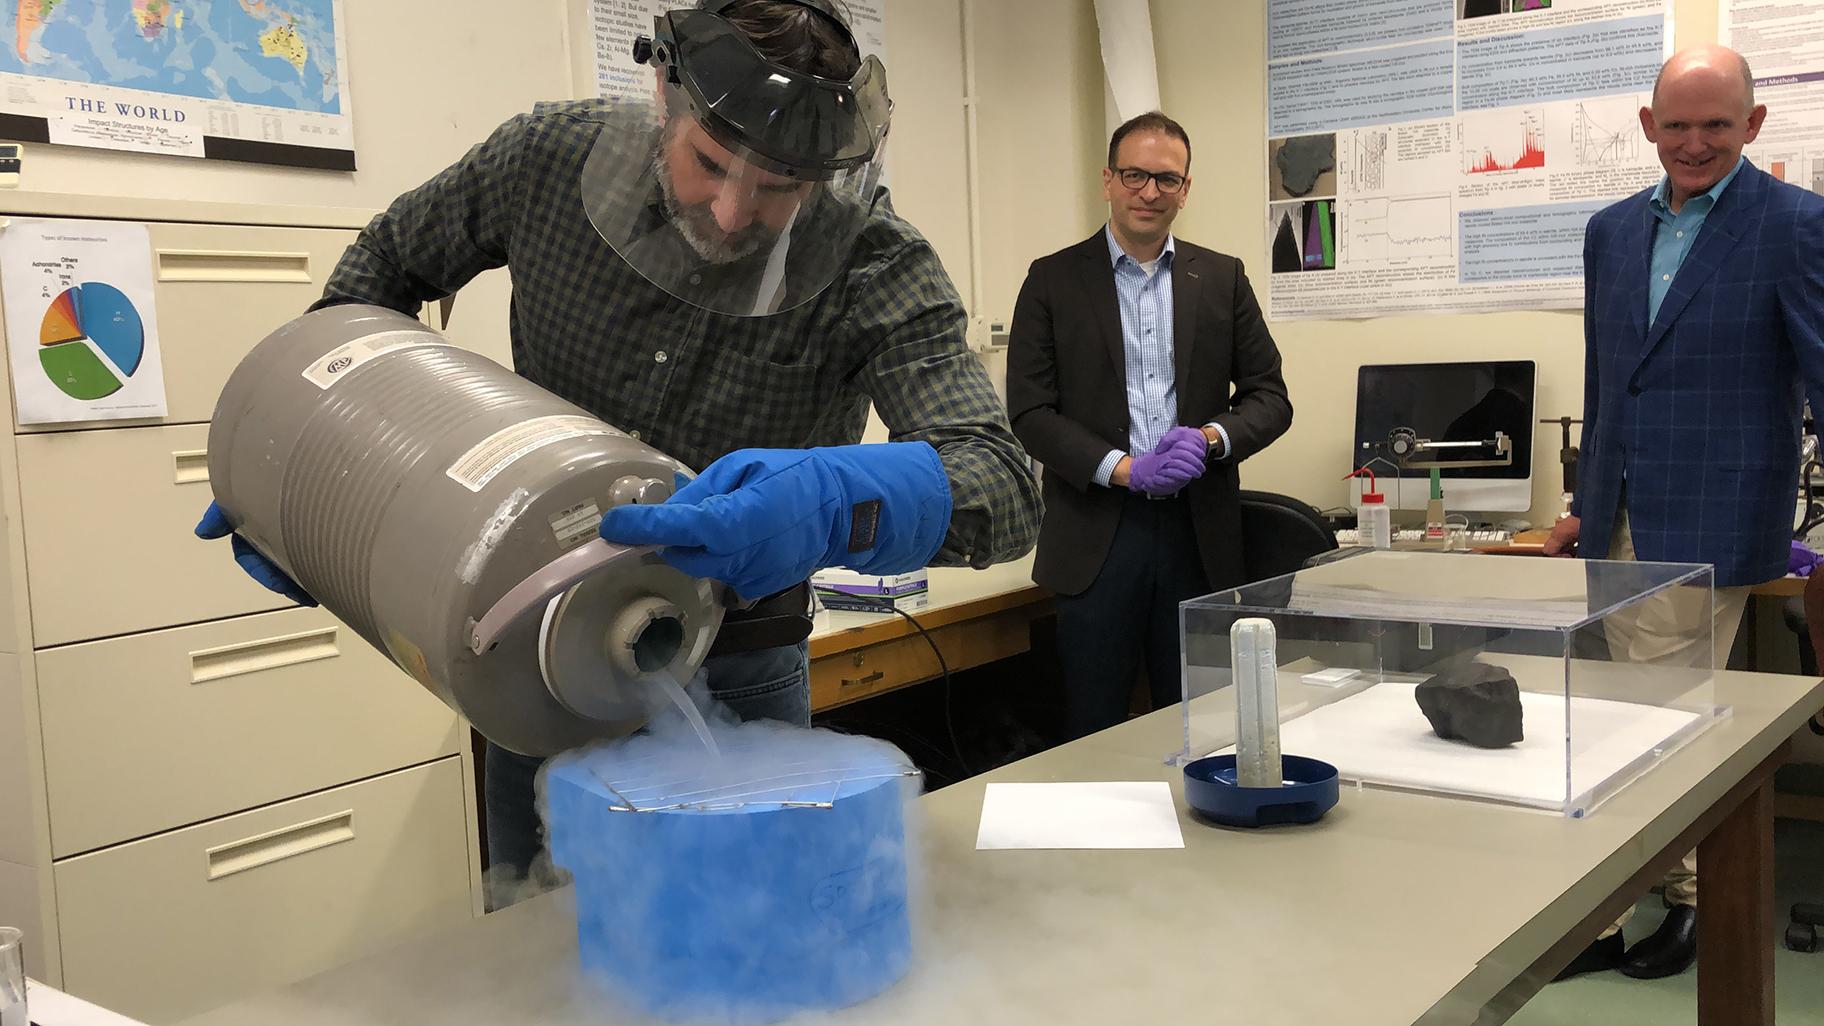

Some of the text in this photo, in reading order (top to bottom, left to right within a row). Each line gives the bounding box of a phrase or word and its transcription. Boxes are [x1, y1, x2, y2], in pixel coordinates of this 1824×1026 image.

[609, 27, 626, 35] limited
[1457, 39, 1479, 47] Results
[607, 65, 620, 73] have
[1268, 63, 1290, 71] Samples
[1754, 76, 1799, 87] and Methods
[65, 97, 106, 113] THE
[115, 103, 186, 122] WORLD
[88, 118, 169, 134] Impact Structures by Age
